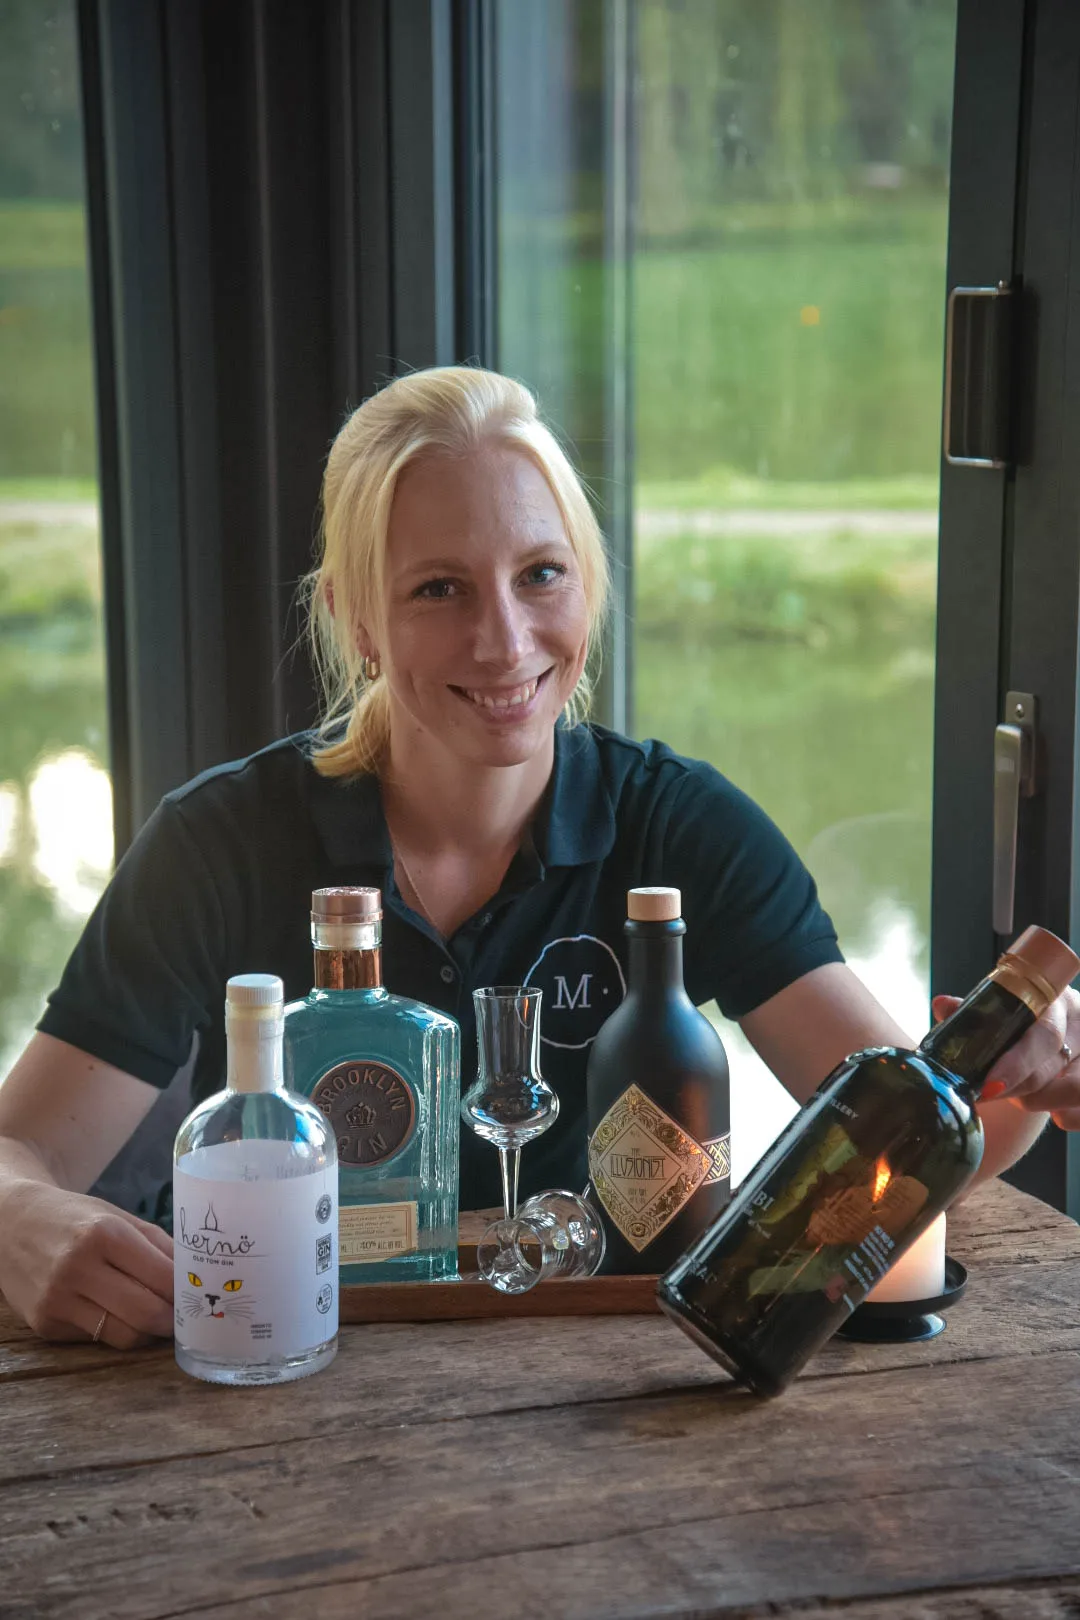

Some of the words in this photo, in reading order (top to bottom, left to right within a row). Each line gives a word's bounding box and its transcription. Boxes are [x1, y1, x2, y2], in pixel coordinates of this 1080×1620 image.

[318, 1068, 406, 1114] BROOKLYN
[610, 1155, 666, 1178] ILLUSIONIST
[179, 1206, 255, 1256] hernö
[193, 1255, 204, 1263] OLD
[206, 1257, 219, 1265] TOM
[222, 1259, 234, 1267] GIN
[317, 1244, 331, 1258] GIN
